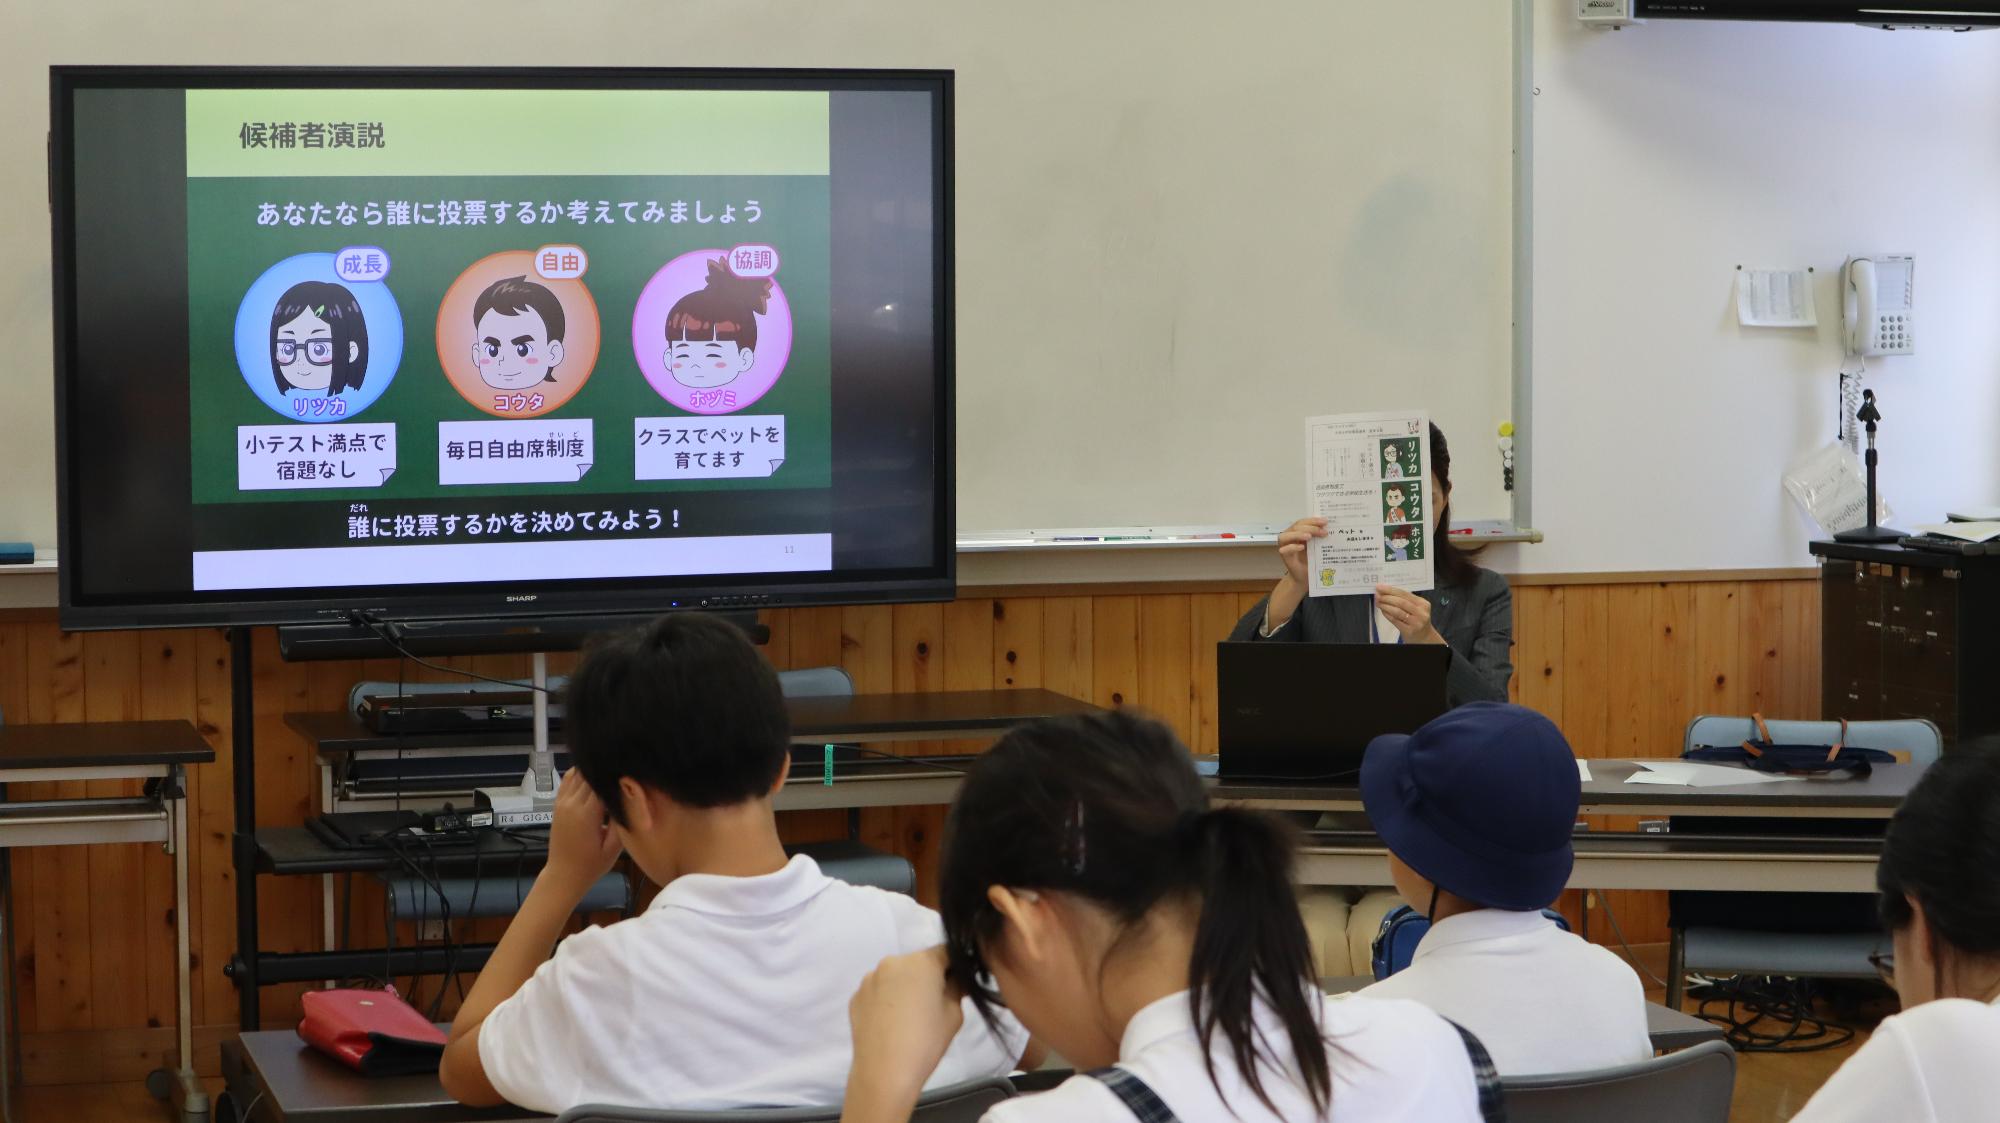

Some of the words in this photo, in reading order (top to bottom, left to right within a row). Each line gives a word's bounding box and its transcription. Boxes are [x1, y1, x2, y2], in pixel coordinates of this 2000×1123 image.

[239, 122, 385, 149] 候補者演説
[257, 200, 762, 226] あなたなら誰に投票するか考えてみましょう
[343, 254, 382, 274] 成長
[542, 252, 579, 272] 自由
[735, 250, 772, 269] 協調
[293, 397, 346, 416] リツカ
[494, 393, 544, 411] コウタ
[690, 390, 736, 407] ホヅミ
[245, 432, 387, 455] 小テスト満点で
[638, 426, 780, 446] クラスでペットを
[446, 438, 584, 460] 毎日自由席制度
[1407, 441, 1417, 473] リツカ
[276, 460, 356, 481] 宿題なし
[674, 451, 745, 470] 育てます
[350, 503, 369, 512] だれ
[1410, 483, 1420, 518] コウタ
[784, 545, 795, 554] 11
[501, 815, 514, 823] R4
